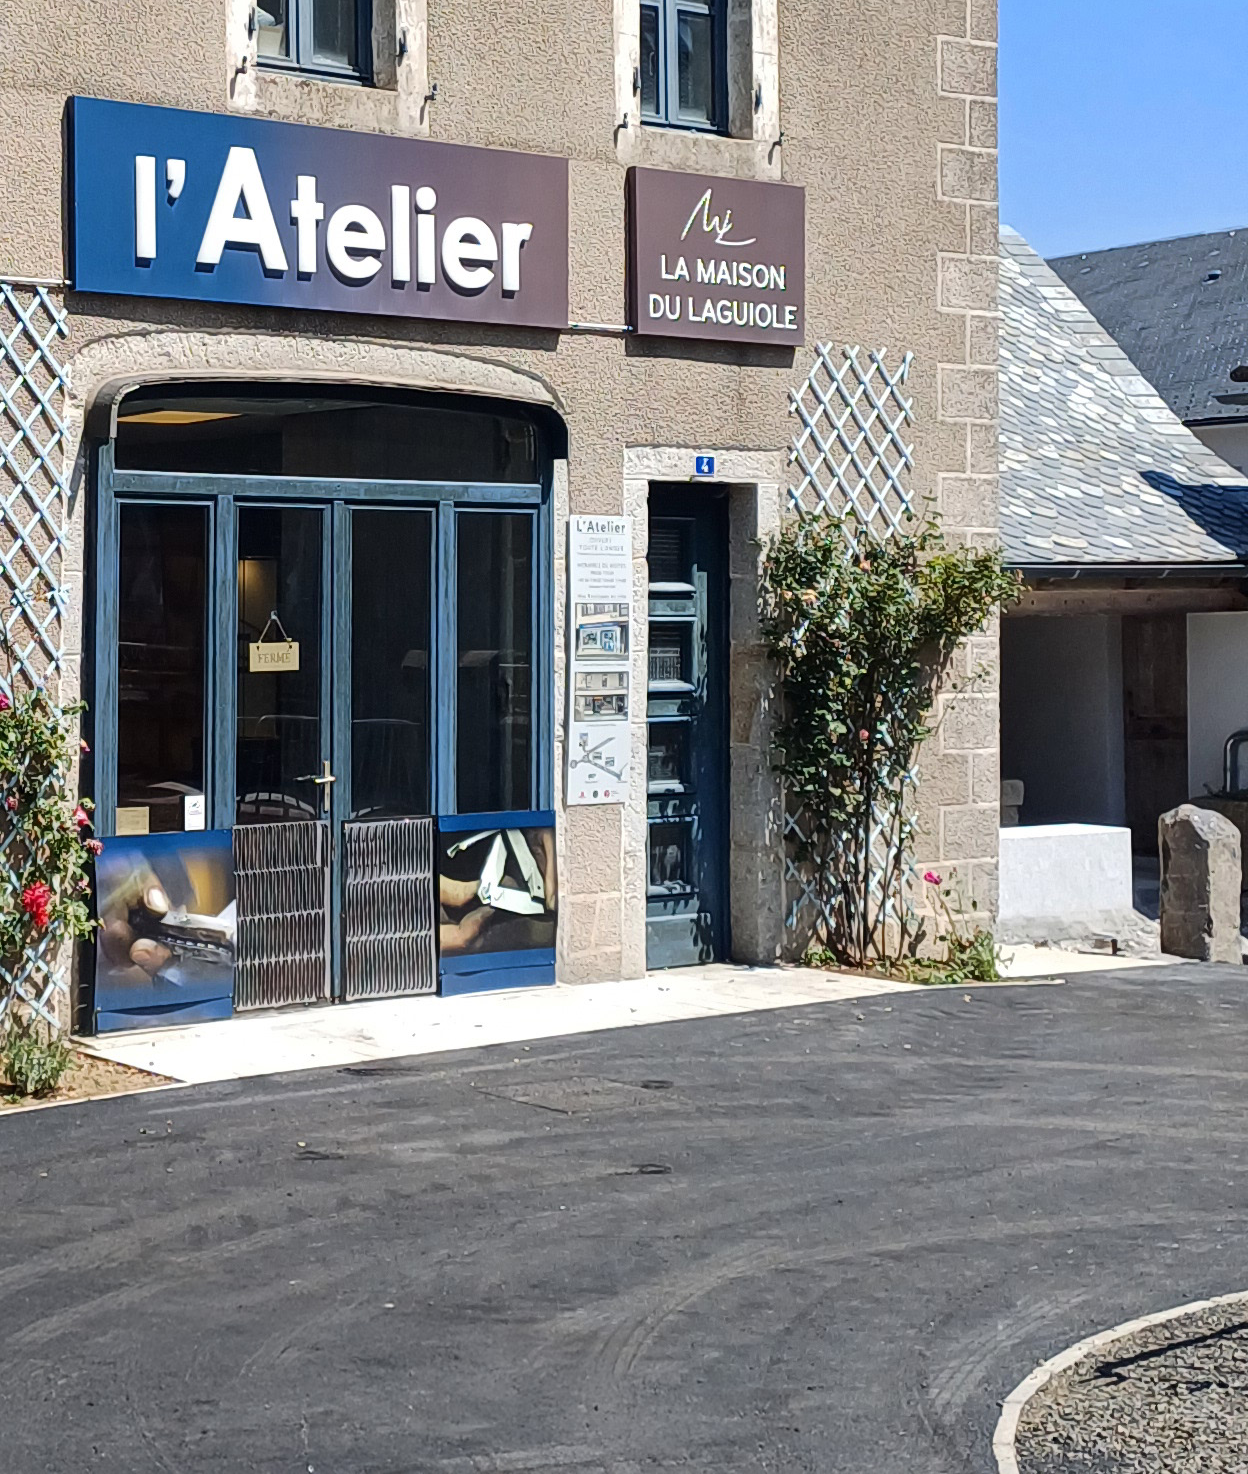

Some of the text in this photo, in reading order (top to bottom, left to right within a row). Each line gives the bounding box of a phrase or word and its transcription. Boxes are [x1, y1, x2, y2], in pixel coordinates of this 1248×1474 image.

[660, 254, 786, 290] LA MAISON
[649, 293, 798, 330] DU LAGUIOLE
[576, 519, 626, 534] L'Atelier
